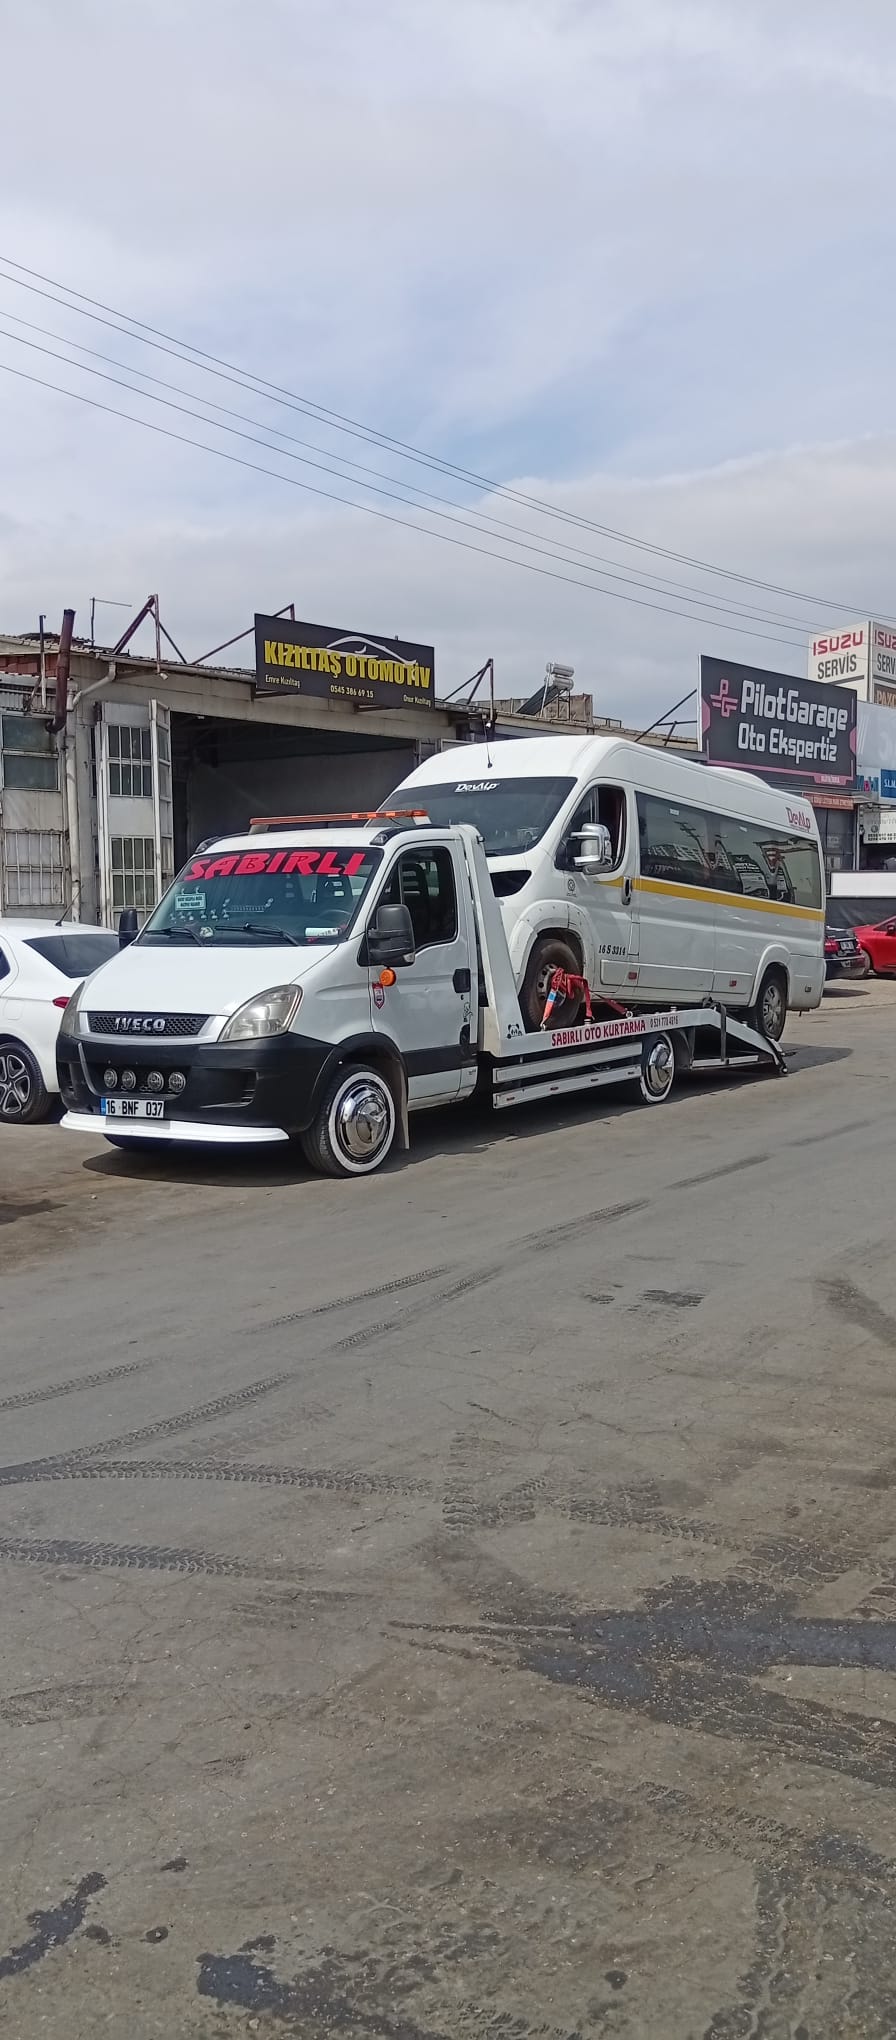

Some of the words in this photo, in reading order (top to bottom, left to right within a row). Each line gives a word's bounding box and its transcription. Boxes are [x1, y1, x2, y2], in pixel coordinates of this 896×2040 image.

[813, 630, 863, 656] ISUZU
[264, 640, 341, 678] KIZILTAŞ
[346, 654, 431, 688] OTOMOTİV
[817, 652, 857, 680] SERVİS
[330, 685, 345, 694] 0545
[366, 690, 374, 698] 15
[740, 679, 848, 738] PilotGarage
[737, 722, 766, 752] Oto
[769, 727, 837, 764] Ekspertiz
[184, 851, 366, 881] SABIRLI
[606, 944, 612, 955] S
[115, 1017, 166, 1032] IVECO
[551, 1030, 582, 1047] SABIRLI
[584, 1026, 601, 1041] OTO
[603, 1020, 646, 1038] KURTARMA
[106, 1100, 115, 1114] 16
[122, 1101, 139, 1116] BNF
[146, 1101, 163, 1117] 037
